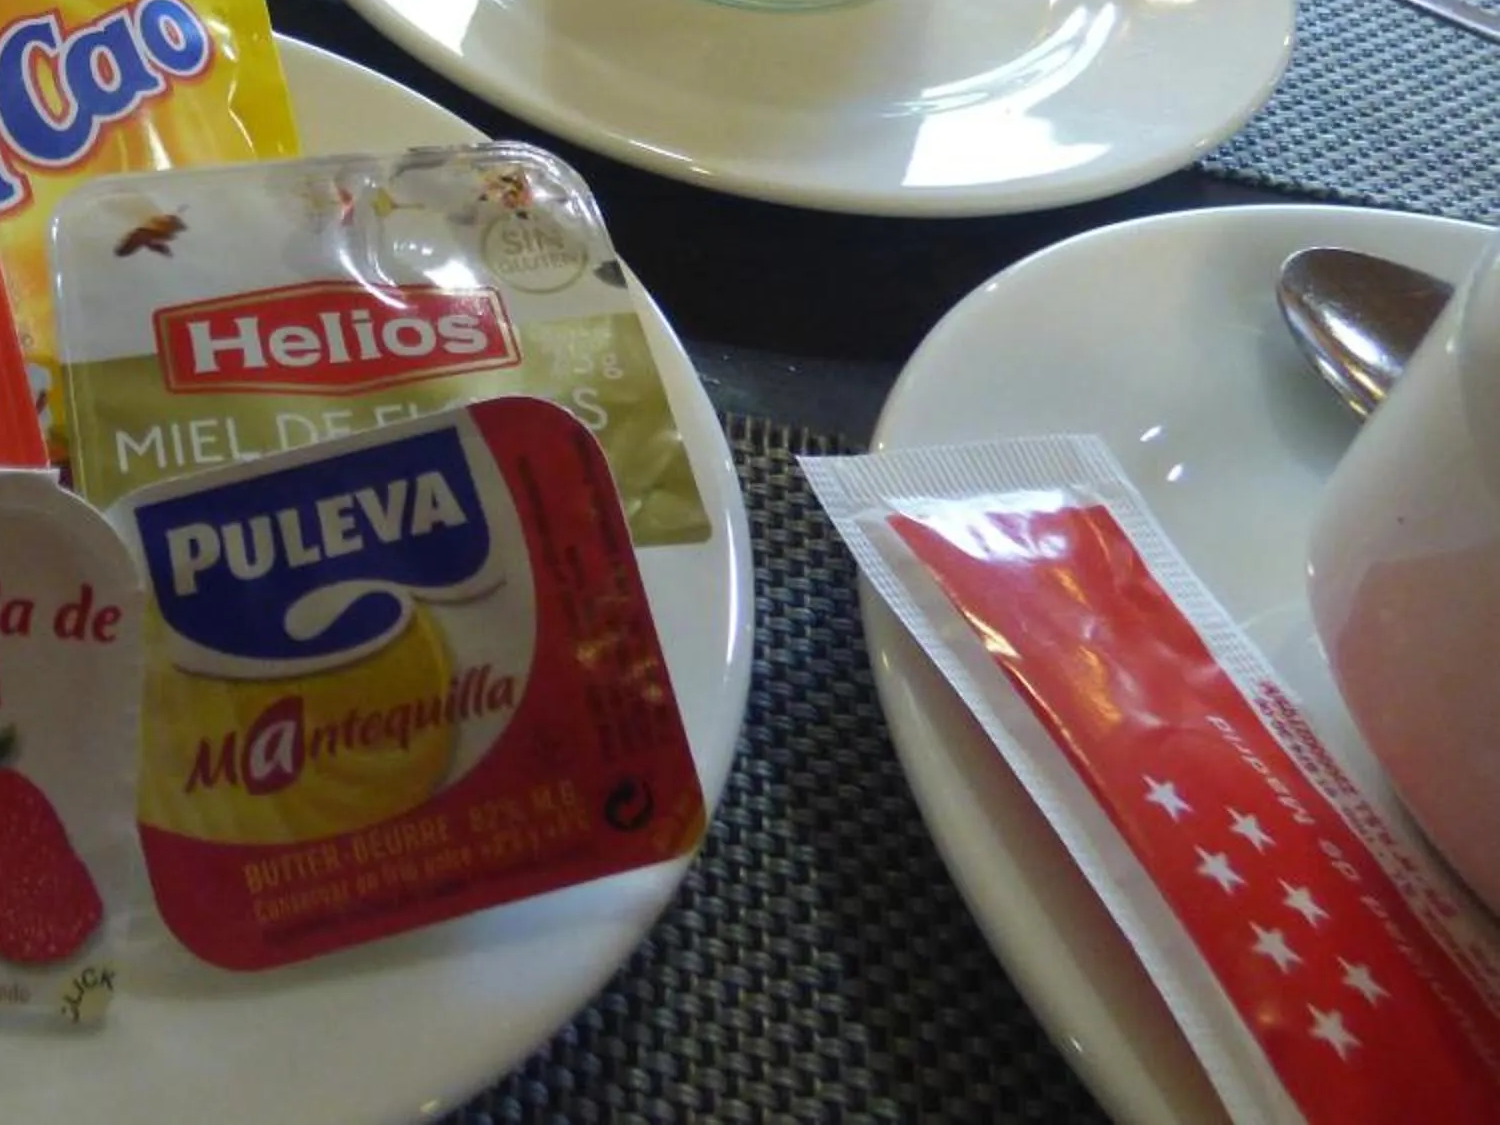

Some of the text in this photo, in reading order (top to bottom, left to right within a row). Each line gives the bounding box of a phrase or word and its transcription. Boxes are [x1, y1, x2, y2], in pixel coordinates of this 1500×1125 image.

[500, 228, 566, 257] SIN
[186, 307, 491, 375] Helios
[114, 415, 263, 474] MIEL
[166, 470, 468, 597] PULEVA
[53, 583, 123, 644] de
[184, 663, 517, 796] Mantequilla
[1203, 713, 1316, 826] Madrid
[1318, 836, 1362, 884] de
